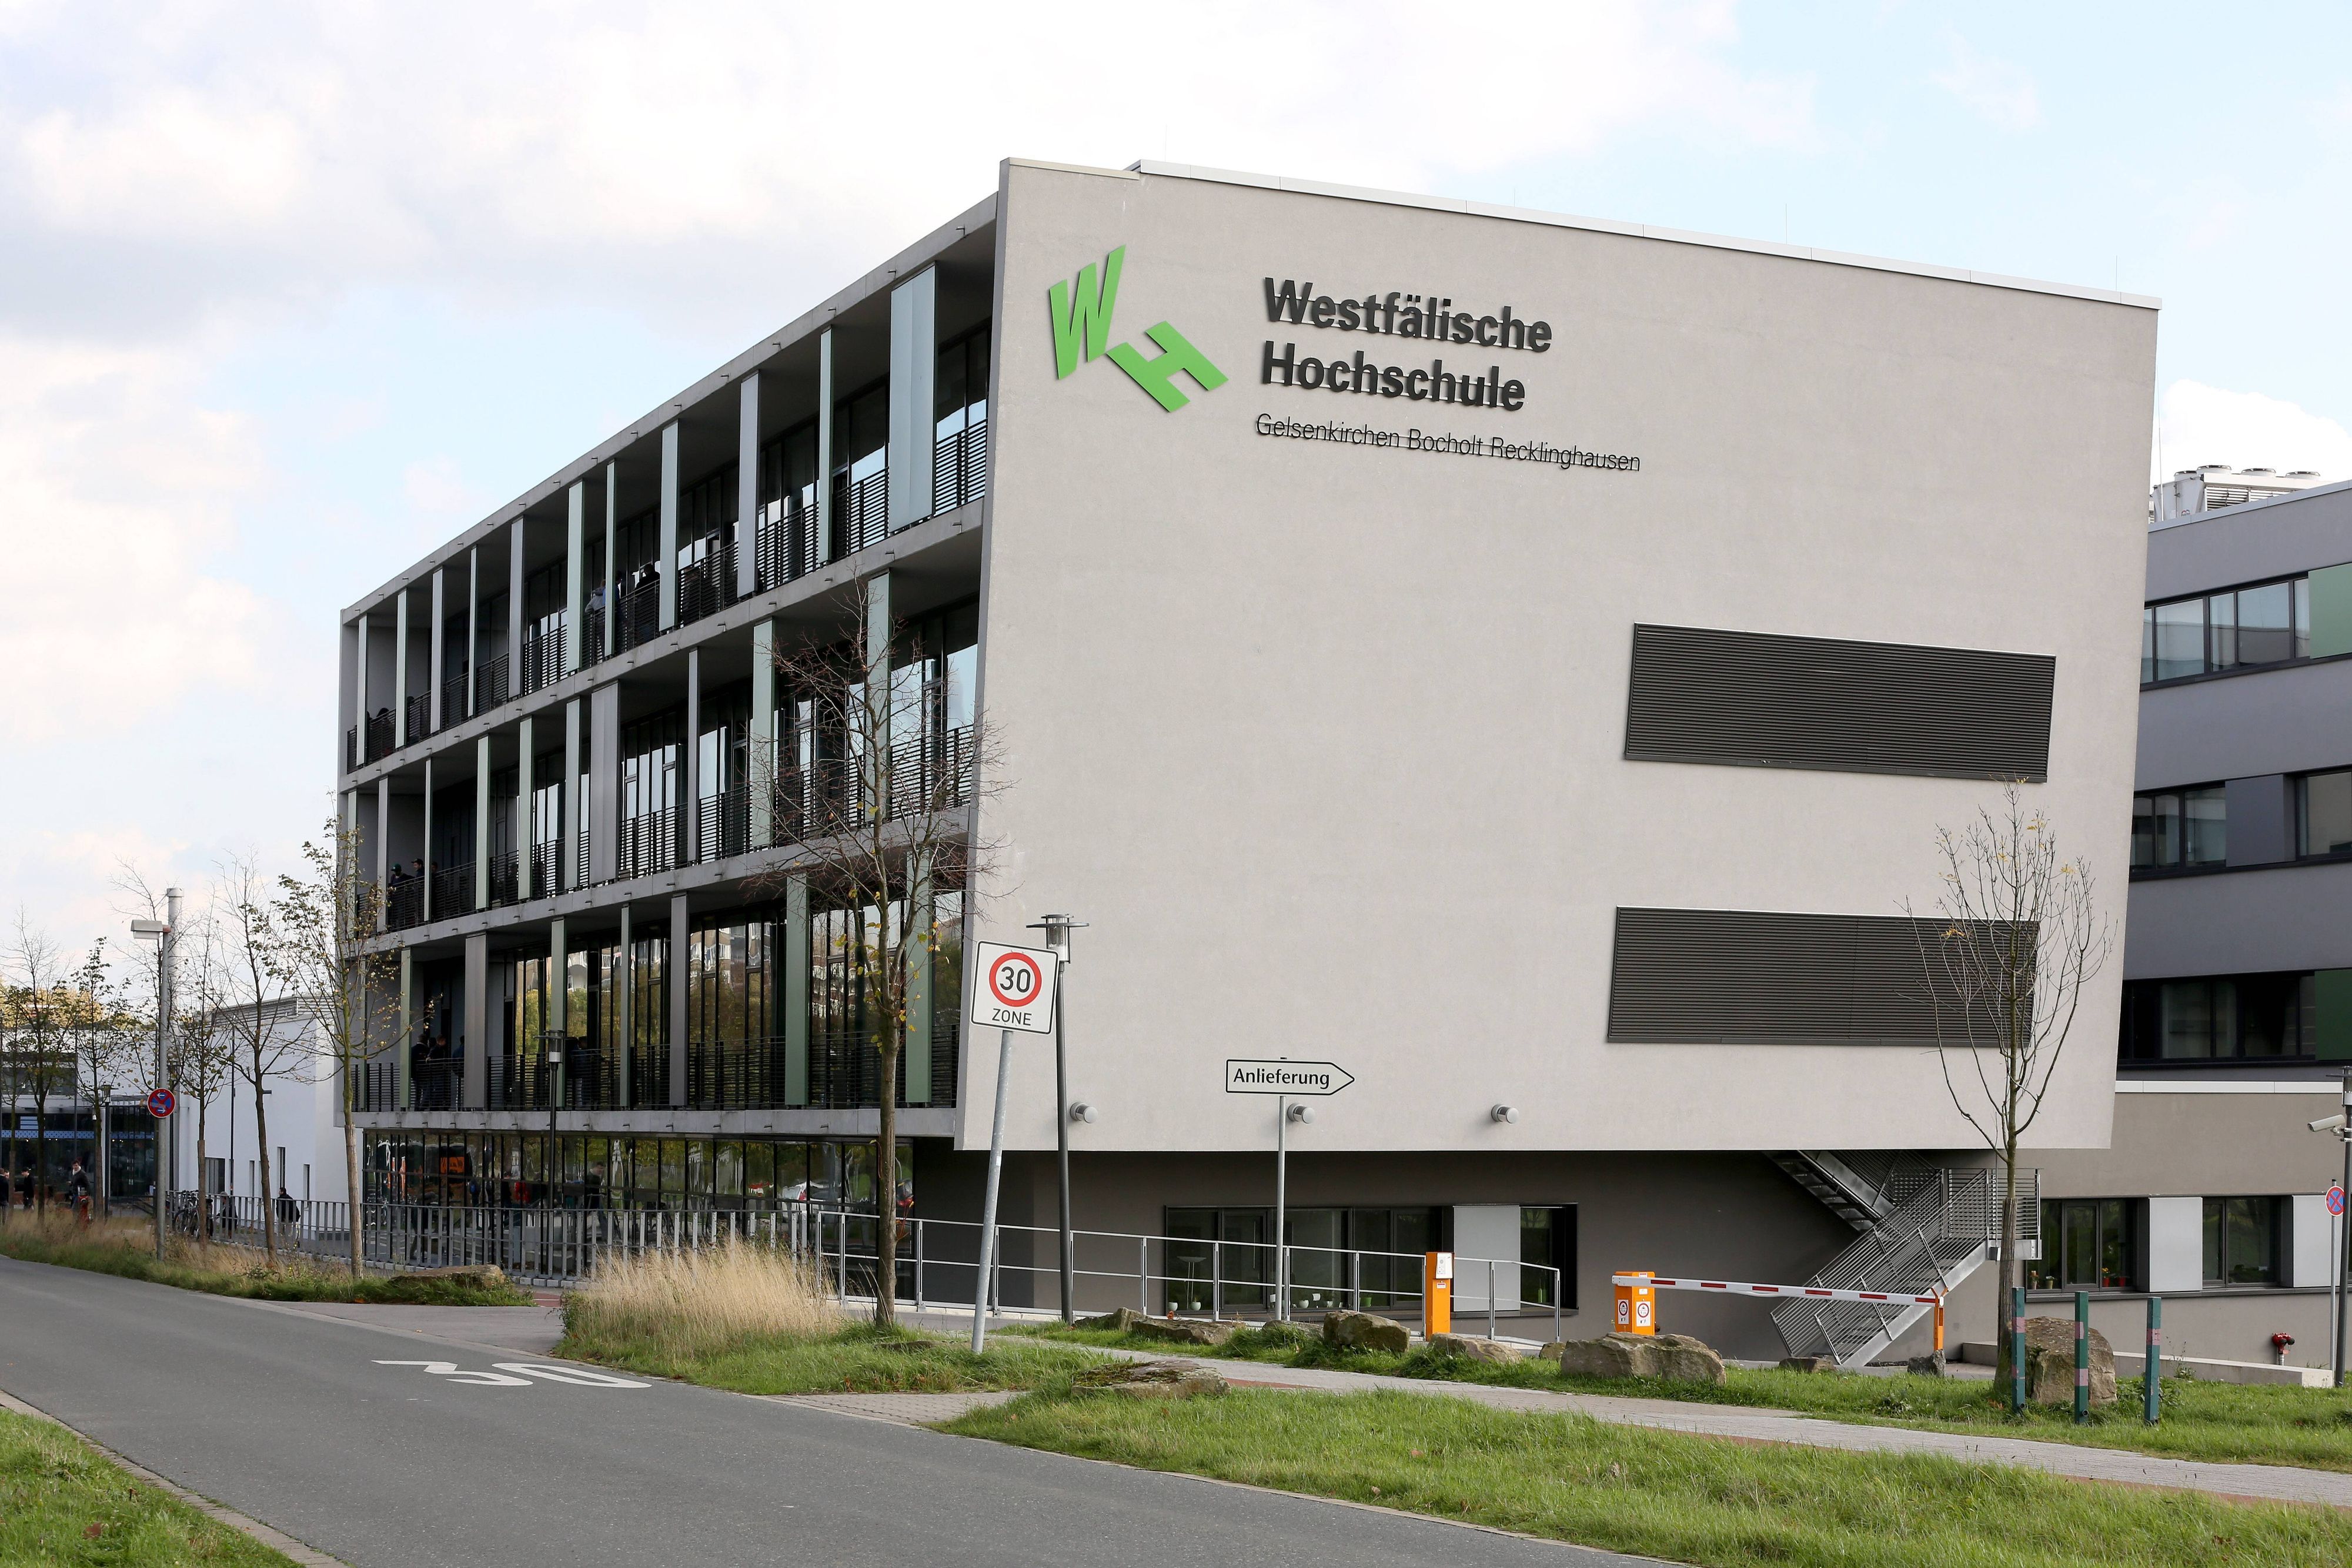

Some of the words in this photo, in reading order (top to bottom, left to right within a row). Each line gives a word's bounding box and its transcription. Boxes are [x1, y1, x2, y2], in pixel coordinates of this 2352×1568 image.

[1264, 278, 1552, 353] Westfälische
[1261, 341, 1525, 411] Hochschule
[1256, 413, 1399, 447] Gelsenkirchen
[1408, 429, 1484, 456] Bocholt
[1491, 437, 1641, 472] Recklinghausen
[1000, 966, 1031, 992] 30
[992, 1008, 1032, 1026] ZONE
[1233, 1068, 1330, 1089] Anlieferung
[372, 1360, 652, 1388] 30
